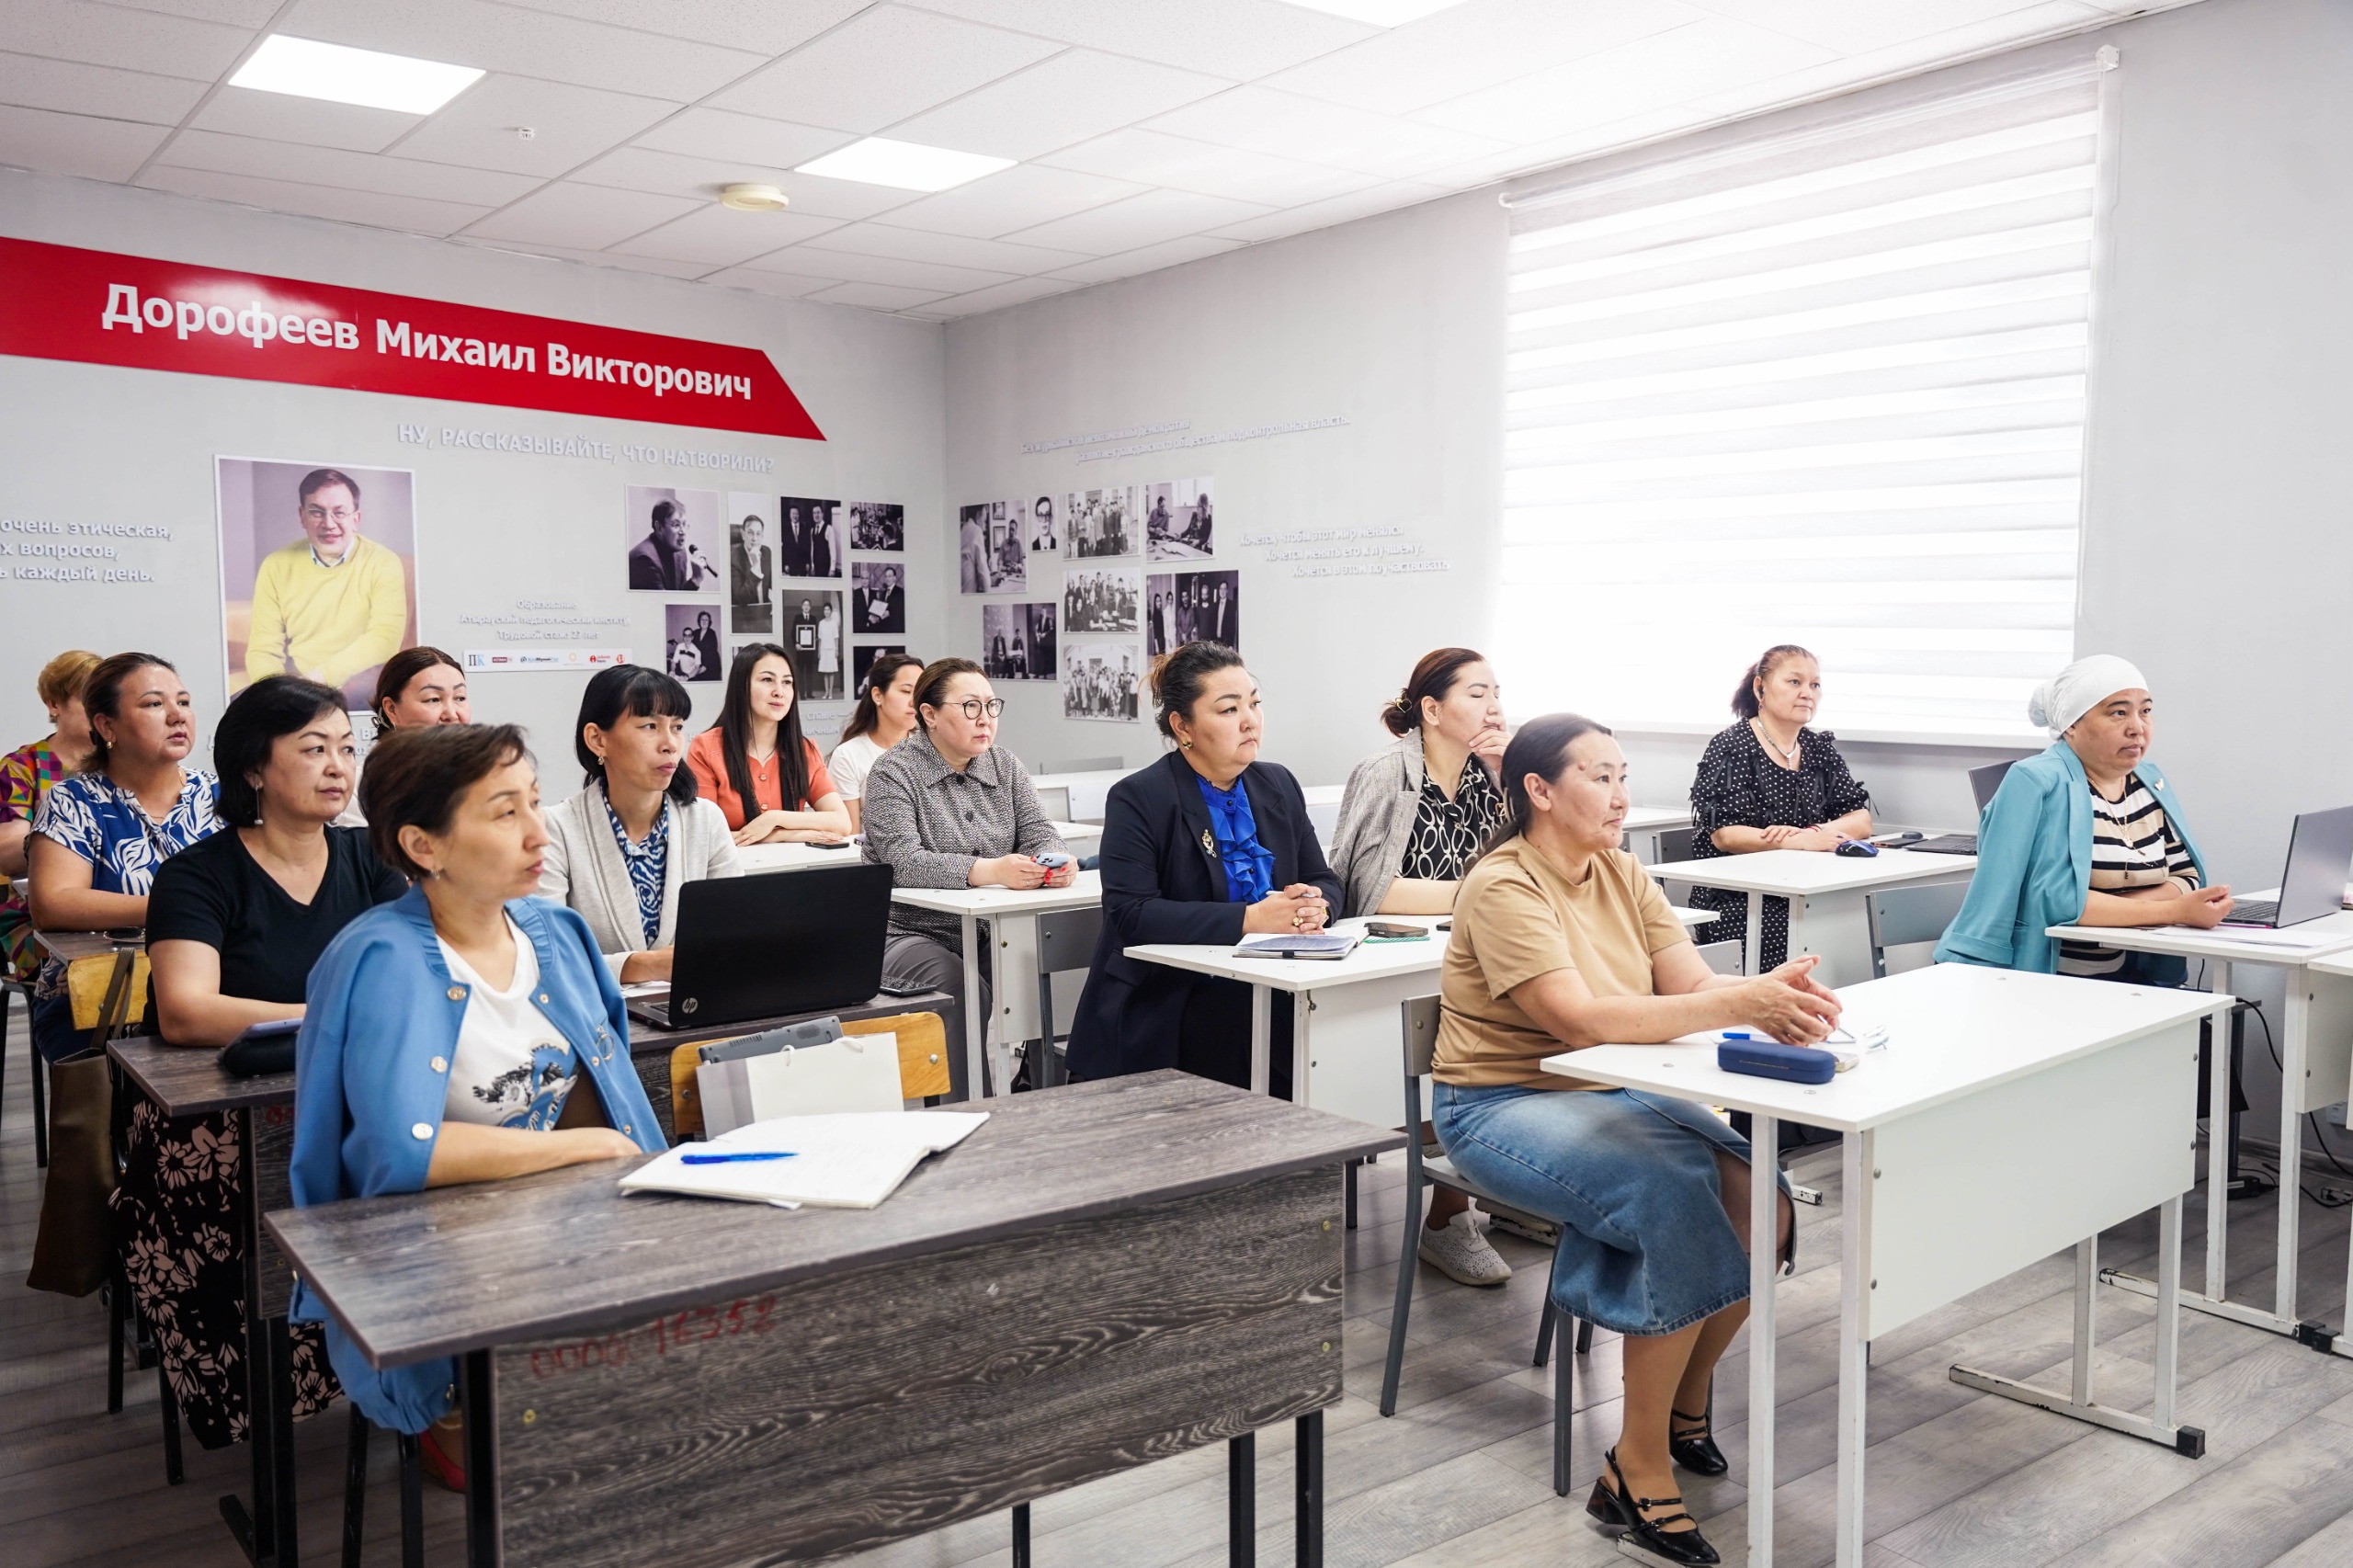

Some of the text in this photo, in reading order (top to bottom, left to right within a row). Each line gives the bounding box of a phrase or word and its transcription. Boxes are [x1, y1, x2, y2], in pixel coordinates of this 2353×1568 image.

[102, 283, 752, 400] Дорофеев Михаил Викторович
[1227, 420, 1309, 442] подконтрольная
[398, 424, 774, 474] НУ, РАССКАЗЫВАЙТЕ, ЧТО НАТВОРИЛИ?
[0, 519, 175, 541] очень этическая,
[1280, 530, 1311, 543] чтобы
[1313, 528, 1335, 541] этот
[1336, 527, 1357, 542] мир
[19, 542, 120, 561] вопросов,
[1266, 547, 1303, 562] Хочется
[1305, 545, 1342, 560] менять
[1343, 545, 1360, 558] его
[1362, 545, 1371, 557] к
[14, 565, 97, 582] каждый
[103, 569, 155, 584] день.
[1292, 563, 1332, 578] Хочется
[1333, 564, 1341, 576] в
[1342, 562, 1367, 576] этом
[682, 997, 699, 1015] hp
